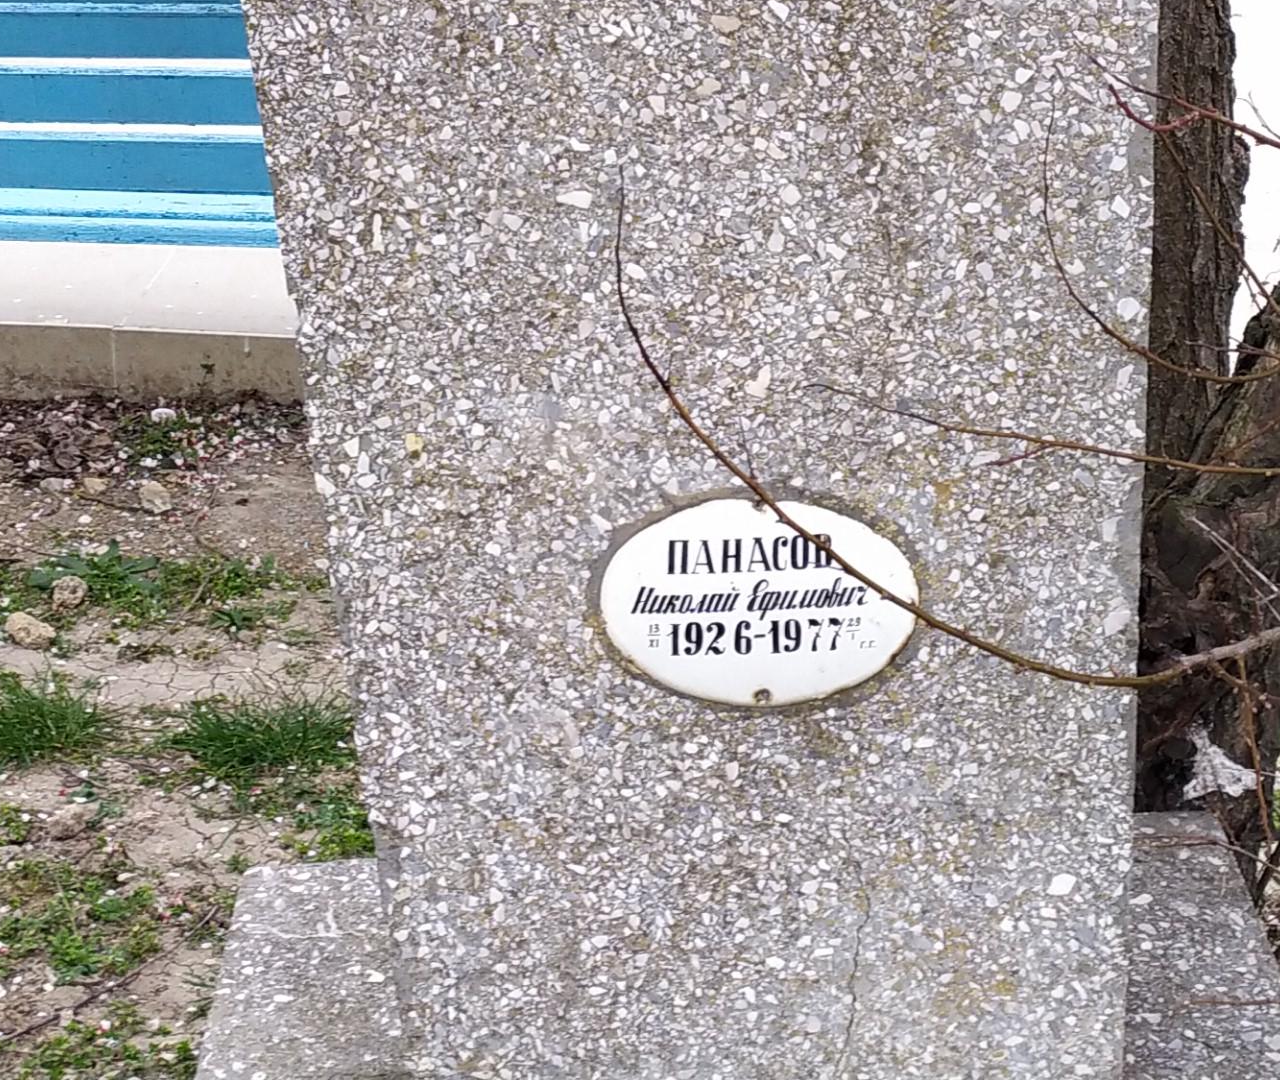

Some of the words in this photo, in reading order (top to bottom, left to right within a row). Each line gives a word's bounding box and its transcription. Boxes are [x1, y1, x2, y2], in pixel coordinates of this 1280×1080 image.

[666, 534, 832, 575] ПАНАСОВ
[631, 585, 740, 614] Николай
[746, 577, 869, 620] Ефимович
[667, 617, 846, 656] 1926-1977
